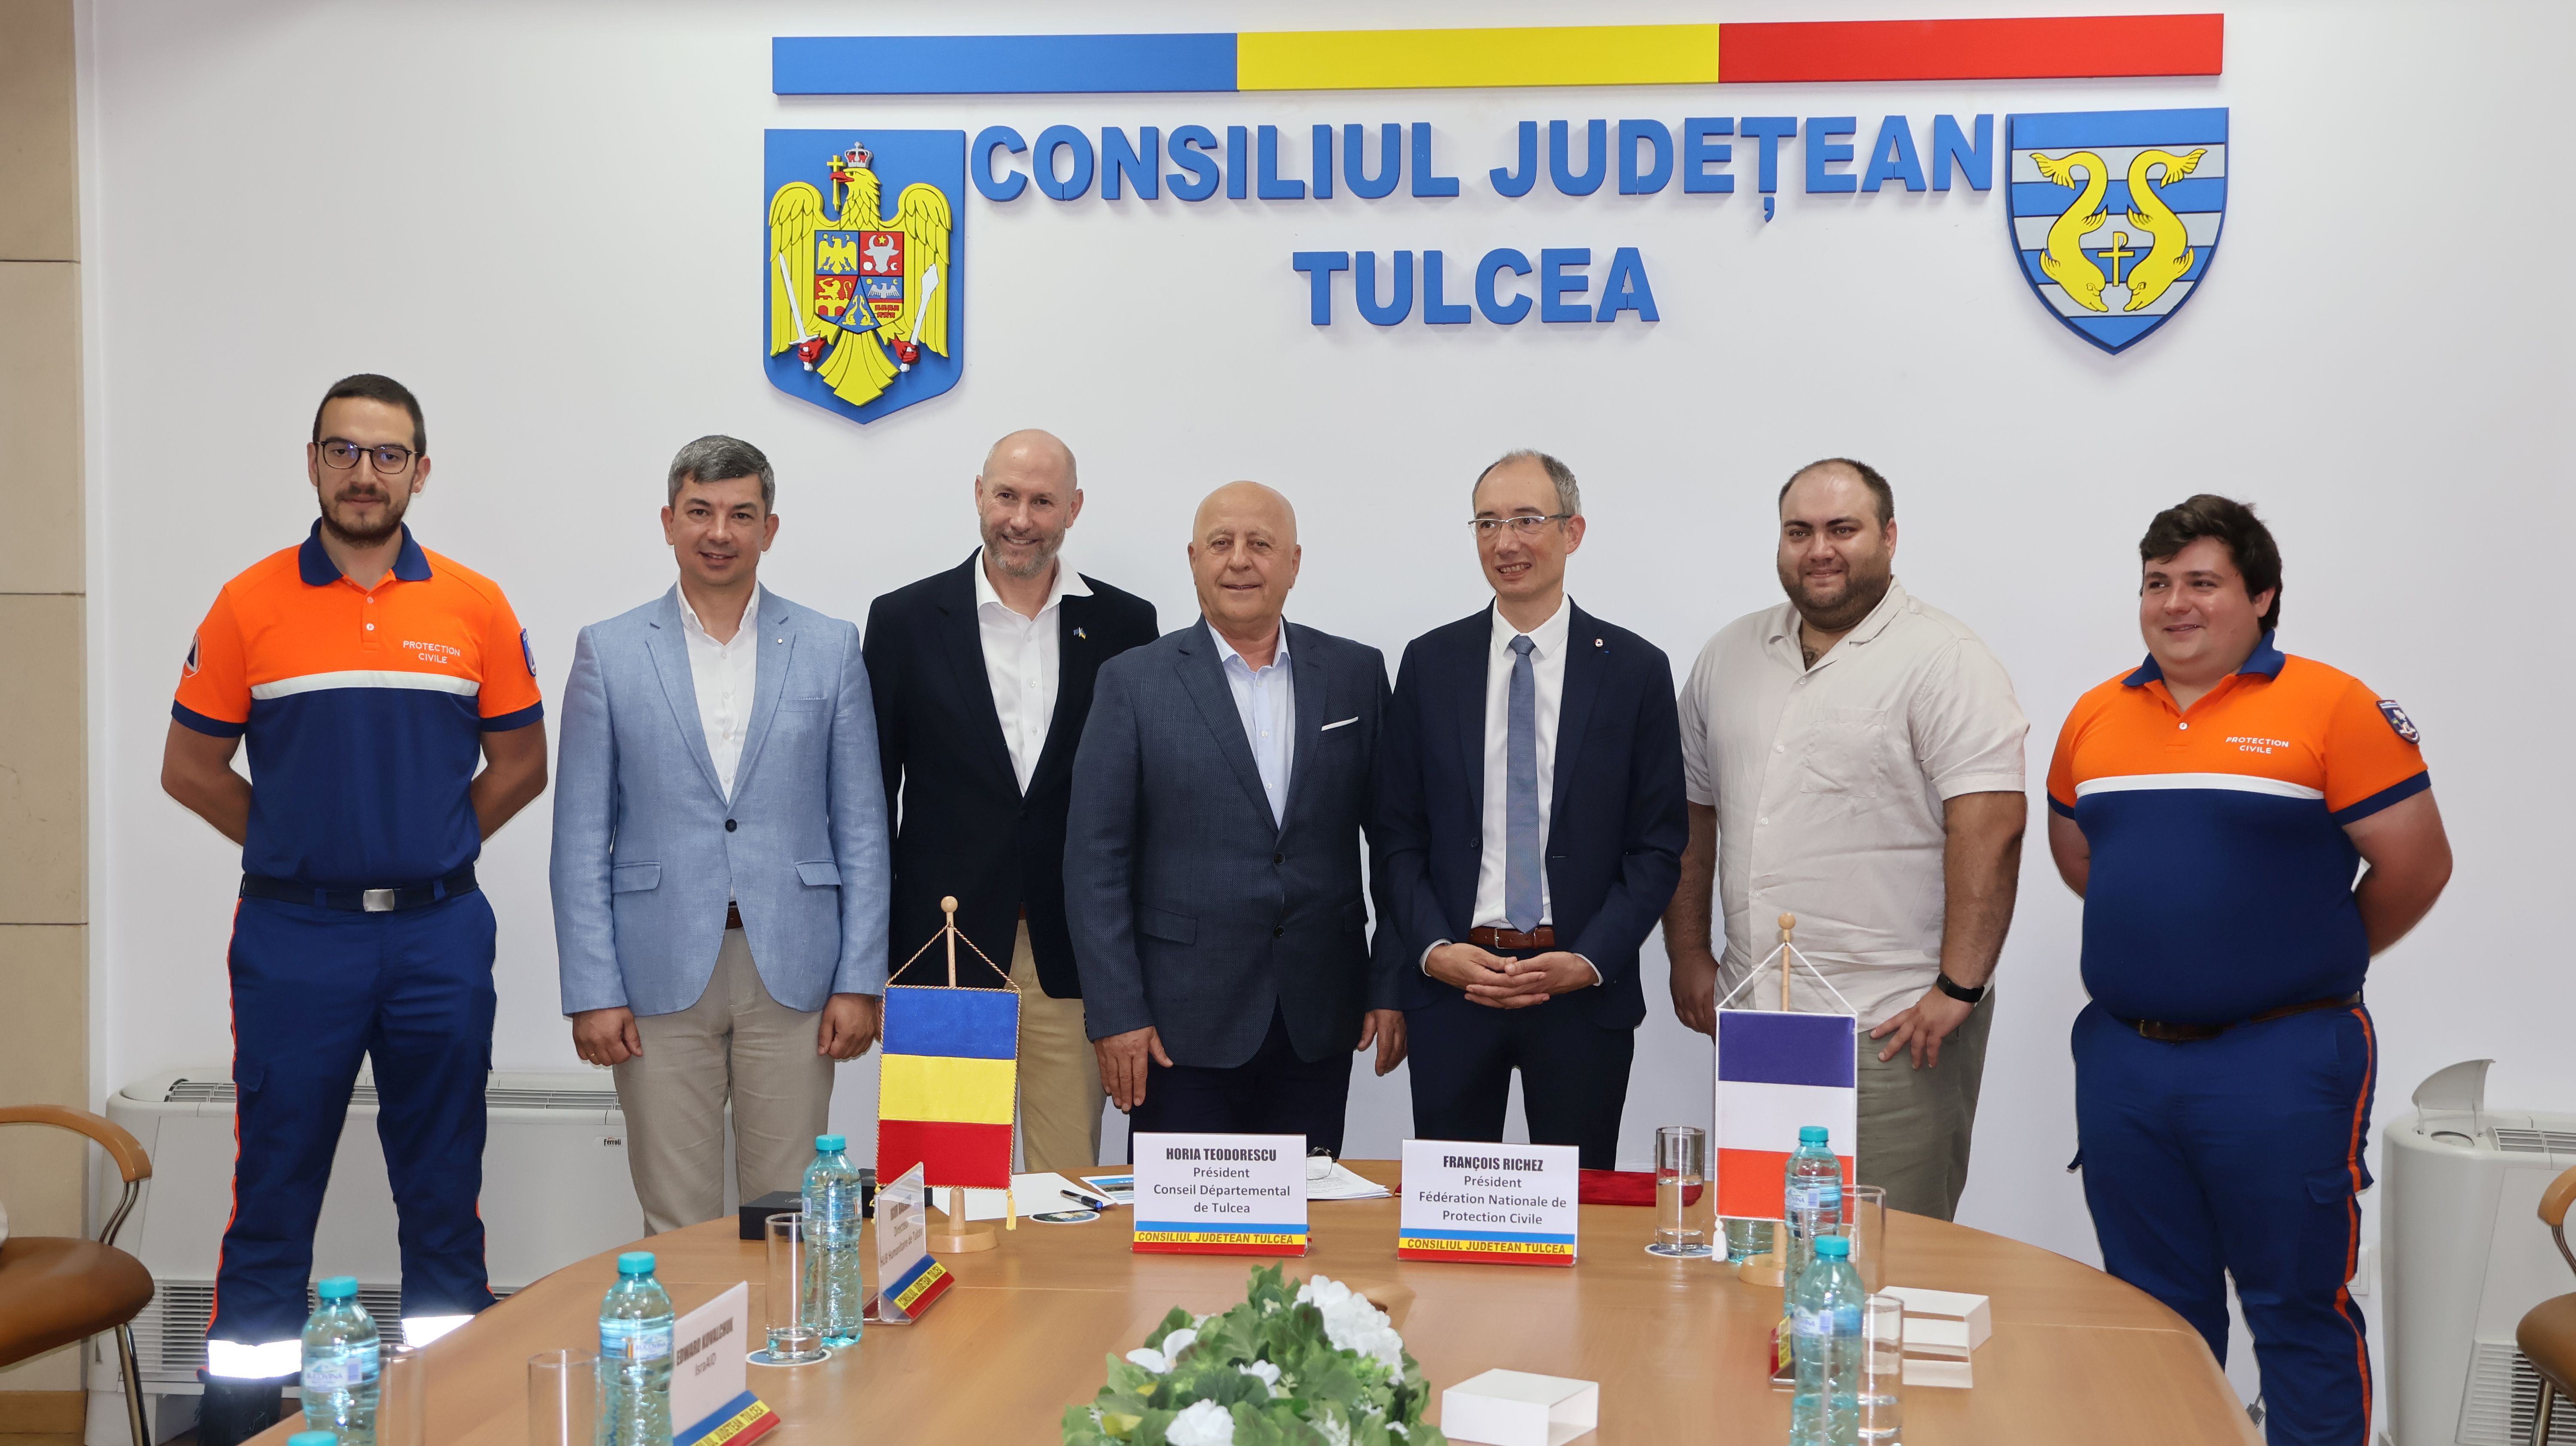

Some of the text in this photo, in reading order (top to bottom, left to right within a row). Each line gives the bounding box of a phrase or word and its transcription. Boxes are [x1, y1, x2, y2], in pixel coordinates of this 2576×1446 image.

[971, 114, 1993, 222] CONSILIUL JUDEȚEAN
[1293, 247, 1660, 326] TULCEA
[403, 640, 460, 656] PROTECTION
[418, 653, 448, 663] CIVILE
[2225, 737, 2289, 747] PROTECTION
[2239, 745, 2272, 754] CIVILE
[1166, 1148, 1277, 1161] HORIA TEODORESCU
[1443, 1155, 1543, 1172] FRANÇOIS RICHEZ
[1193, 1167, 1250, 1178] Président
[1464, 1176, 1522, 1188] Président
[1154, 1184, 1290, 1198] Conseil Départemental
[1419, 1191, 1567, 1207] Fédération Nationale de
[1194, 1203, 1250, 1213] de Tulcea
[1443, 1210, 1543, 1224] Protection Civile
[913, 1228, 923, 1241] Tulcea
[1138, 1232, 1294, 1244] CONSILIUL JUDETEAN TULCEA
[1407, 1239, 1565, 1254] CONSILIUL JUDETEAN TULCEA
[695, 1352, 716, 1375] IsraAID
